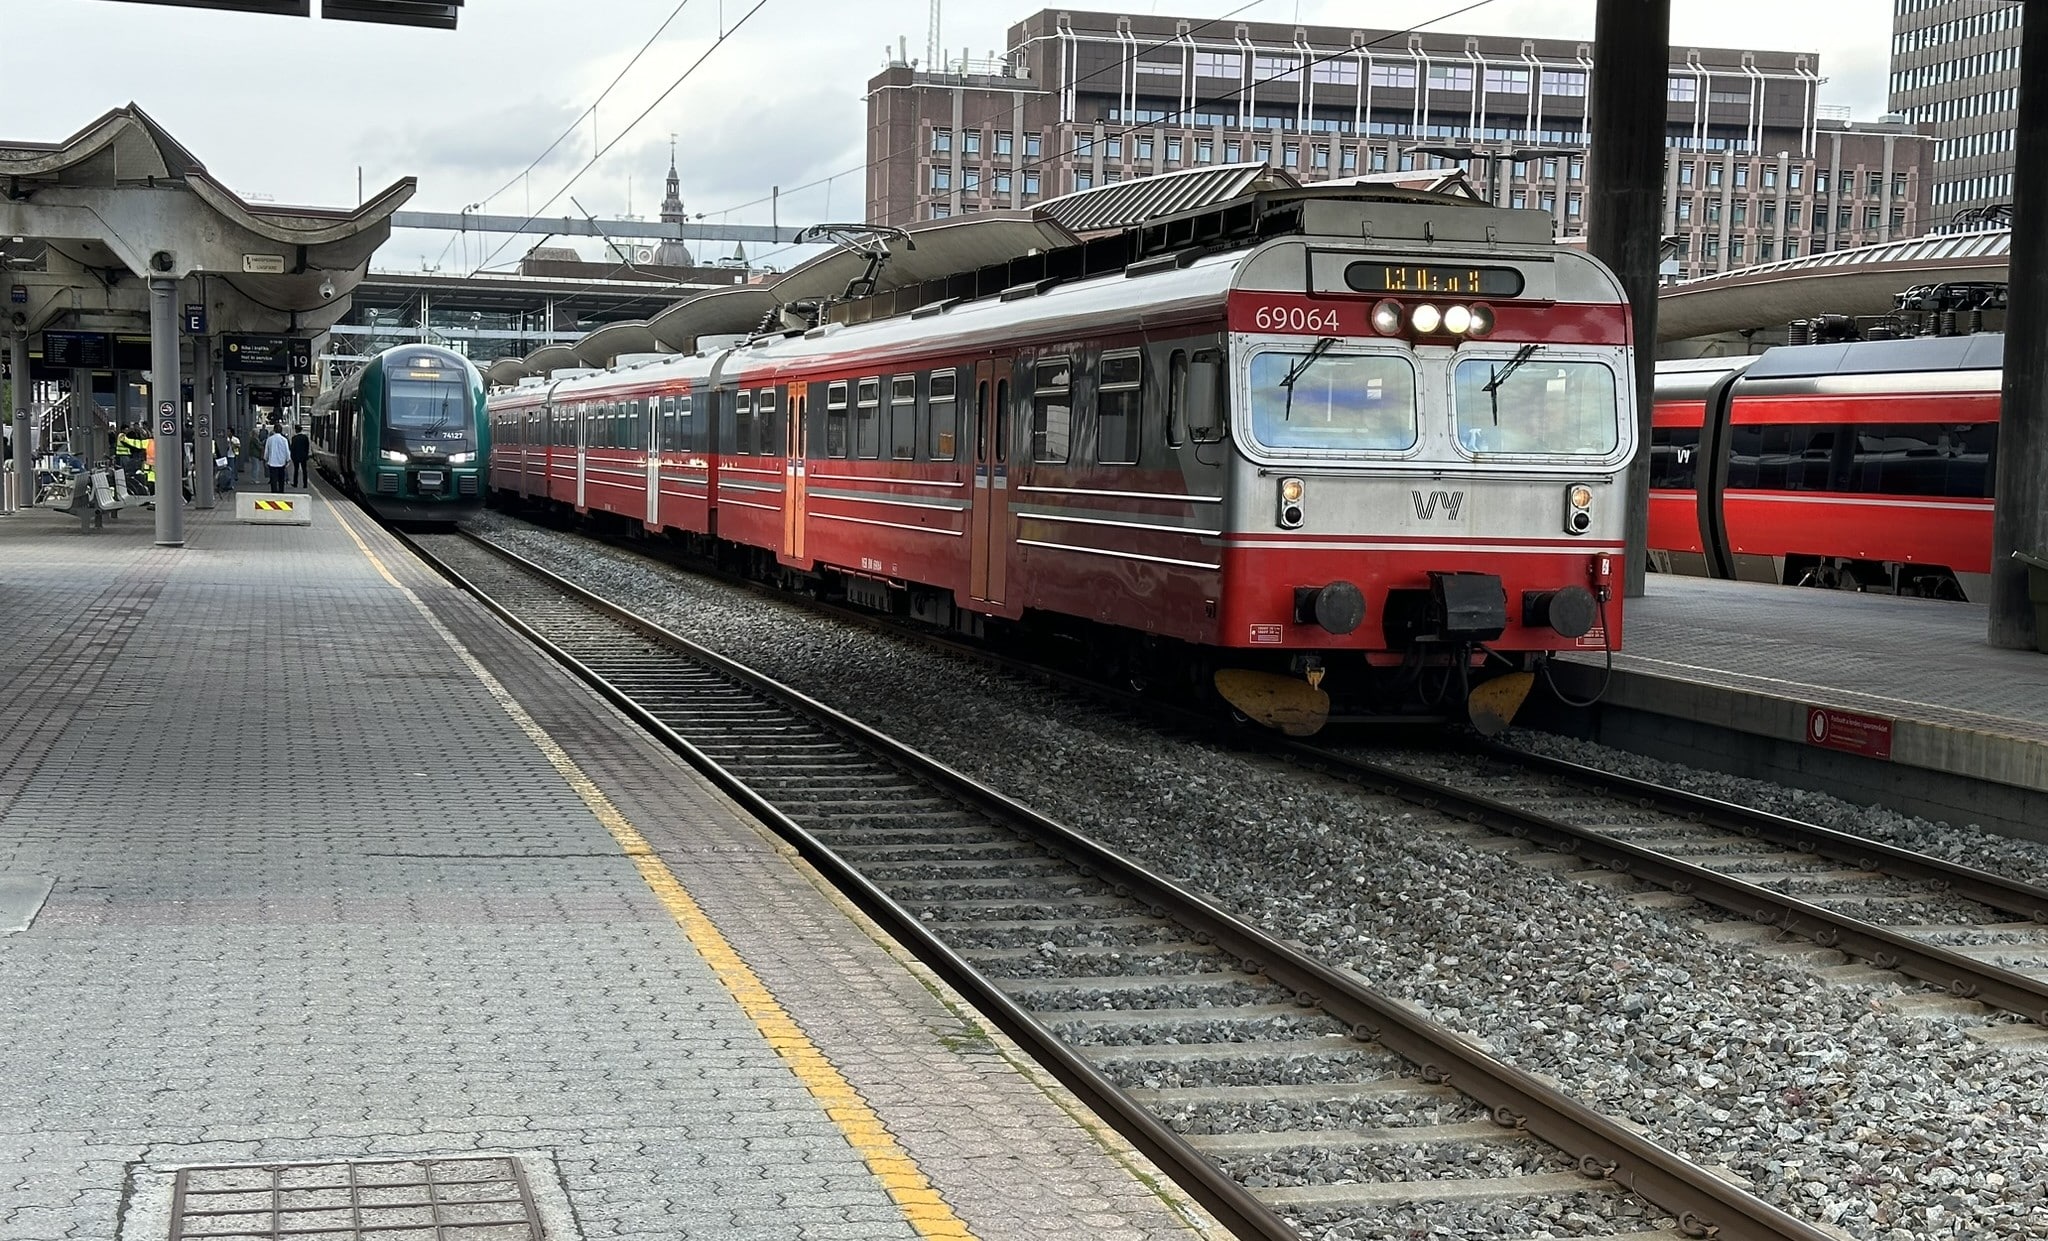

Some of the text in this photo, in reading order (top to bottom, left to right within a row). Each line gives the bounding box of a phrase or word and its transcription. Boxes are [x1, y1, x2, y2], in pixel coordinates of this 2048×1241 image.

[191, 316, 200, 329] E
[1256, 306, 1339, 331] 69064
[292, 355, 308, 368] 19
